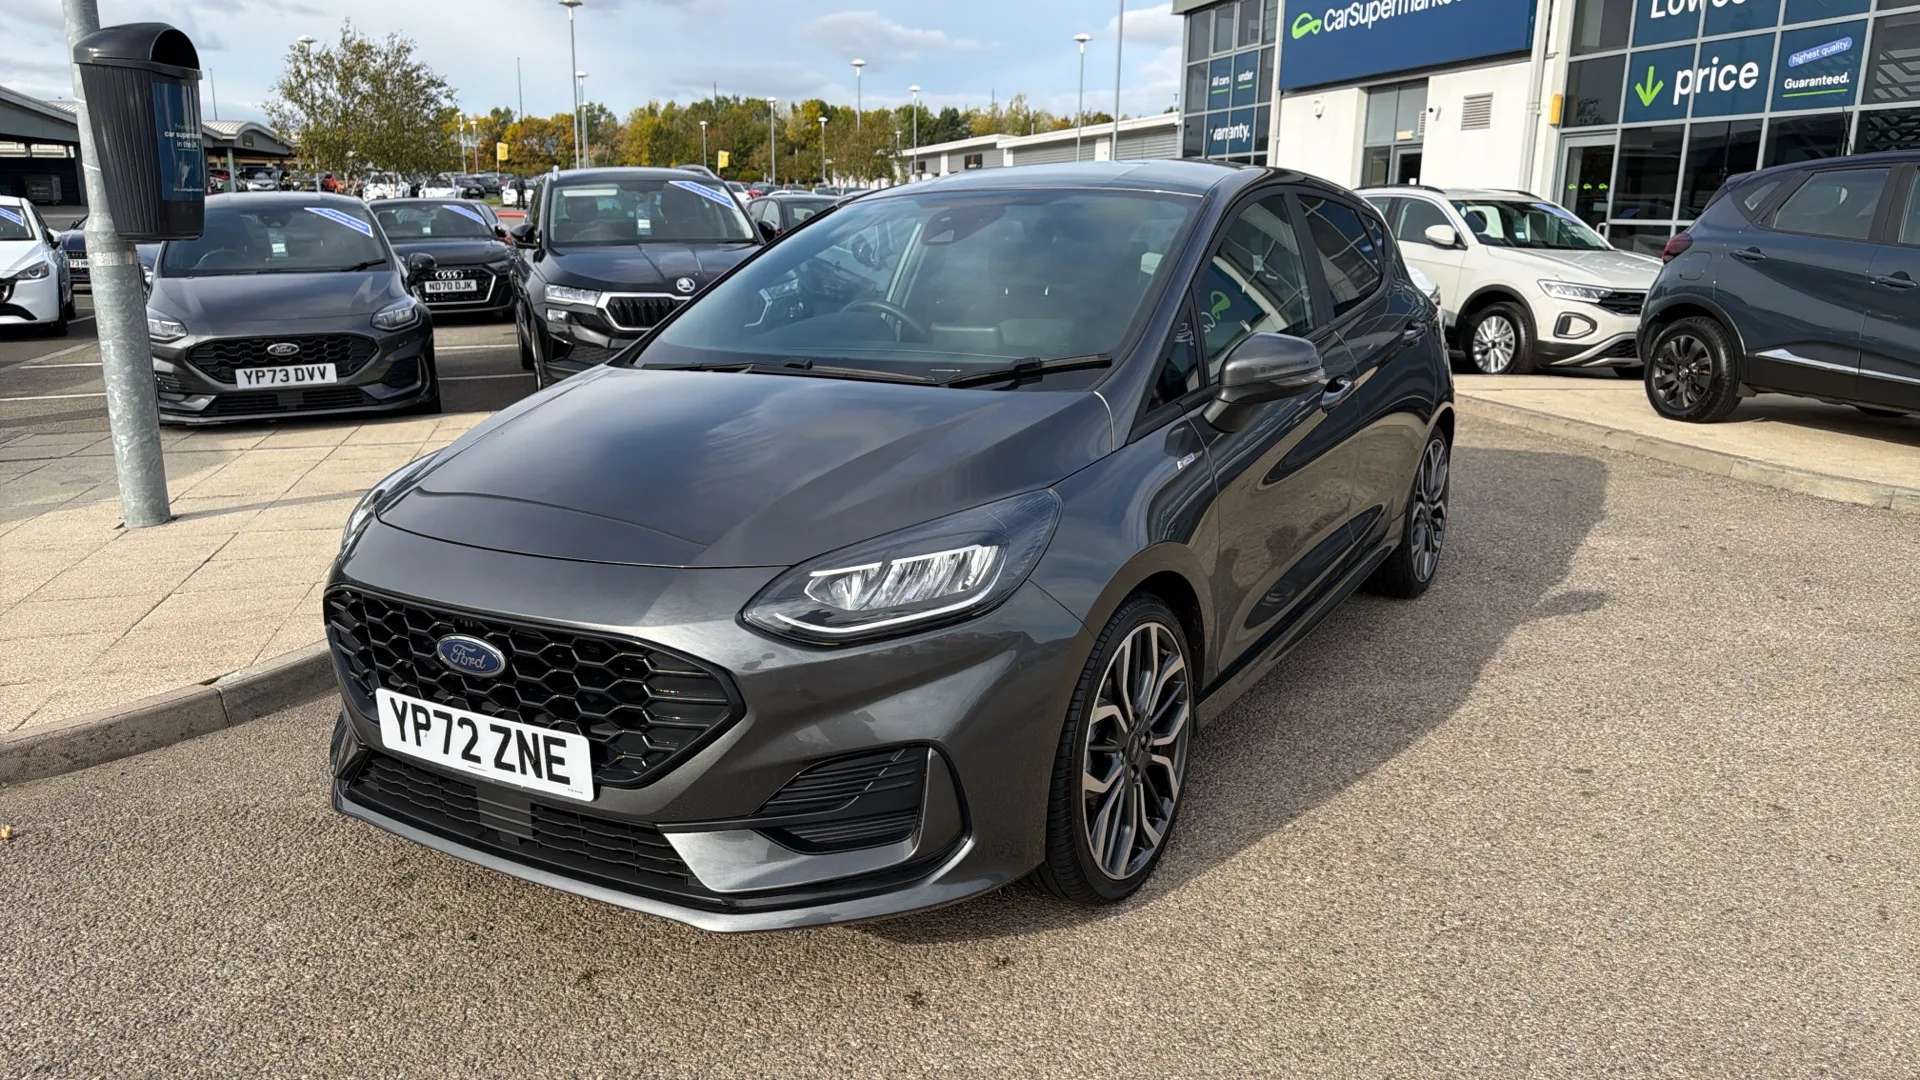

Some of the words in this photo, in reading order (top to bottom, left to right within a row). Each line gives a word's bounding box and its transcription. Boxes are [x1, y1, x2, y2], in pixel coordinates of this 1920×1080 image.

[1792, 48, 1820, 64] highest
[1673, 56, 1759, 105] price
[1784, 72, 1850, 89] Guaranteed.
[243, 368, 290, 385] YP73
[294, 365, 327, 382] DVV
[450, 644, 488, 670] Ford
[389, 697, 482, 765] YP72
[489, 723, 571, 786] ZNE
